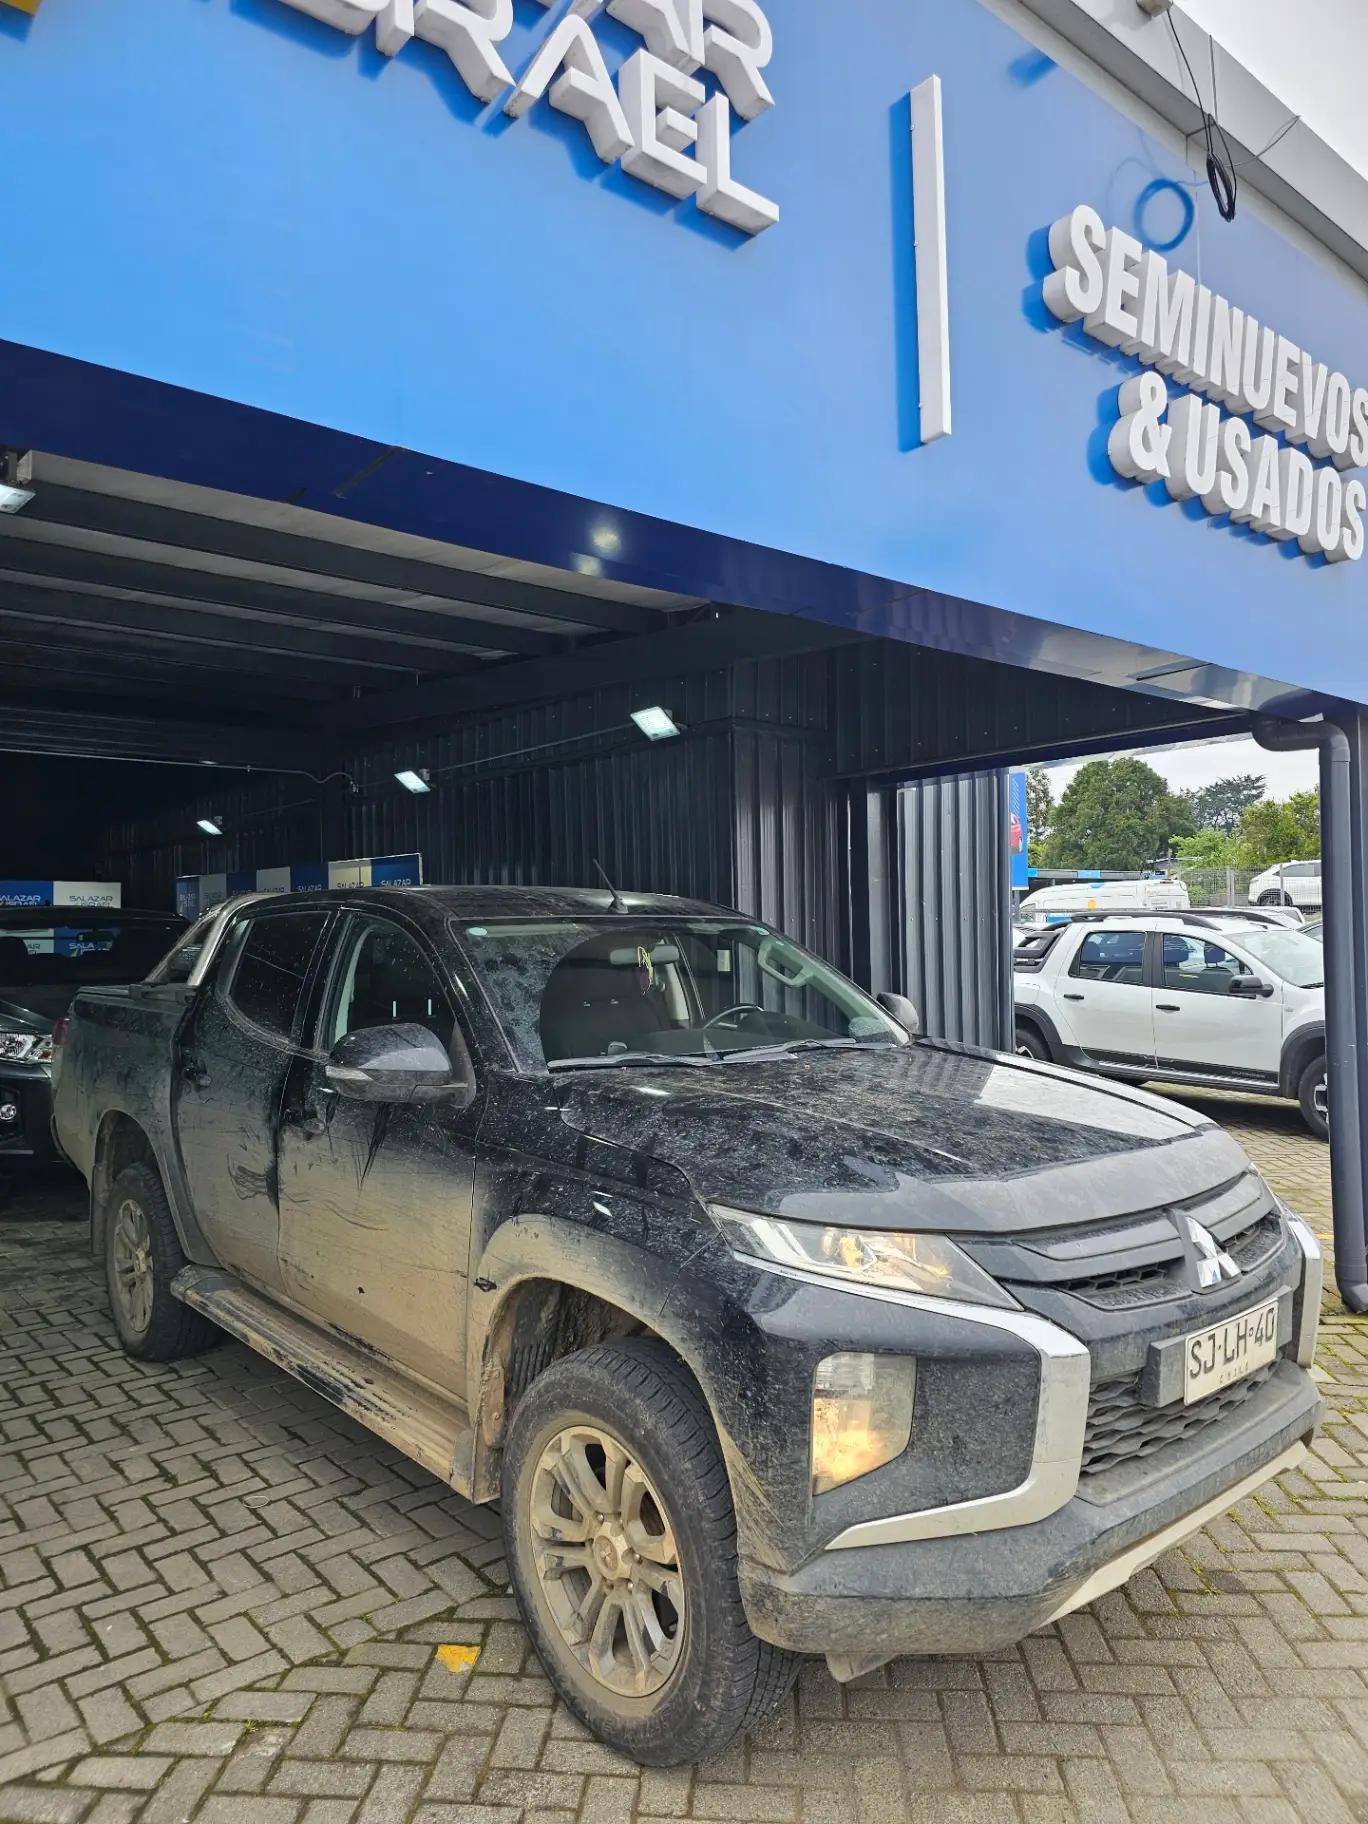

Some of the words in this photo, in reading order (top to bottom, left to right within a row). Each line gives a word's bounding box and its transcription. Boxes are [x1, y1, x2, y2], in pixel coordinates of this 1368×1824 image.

[1043, 204, 1368, 470] SEMINUEVOS
[1108, 371, 1172, 484] &
[1165, 393, 1368, 561] USADOS
